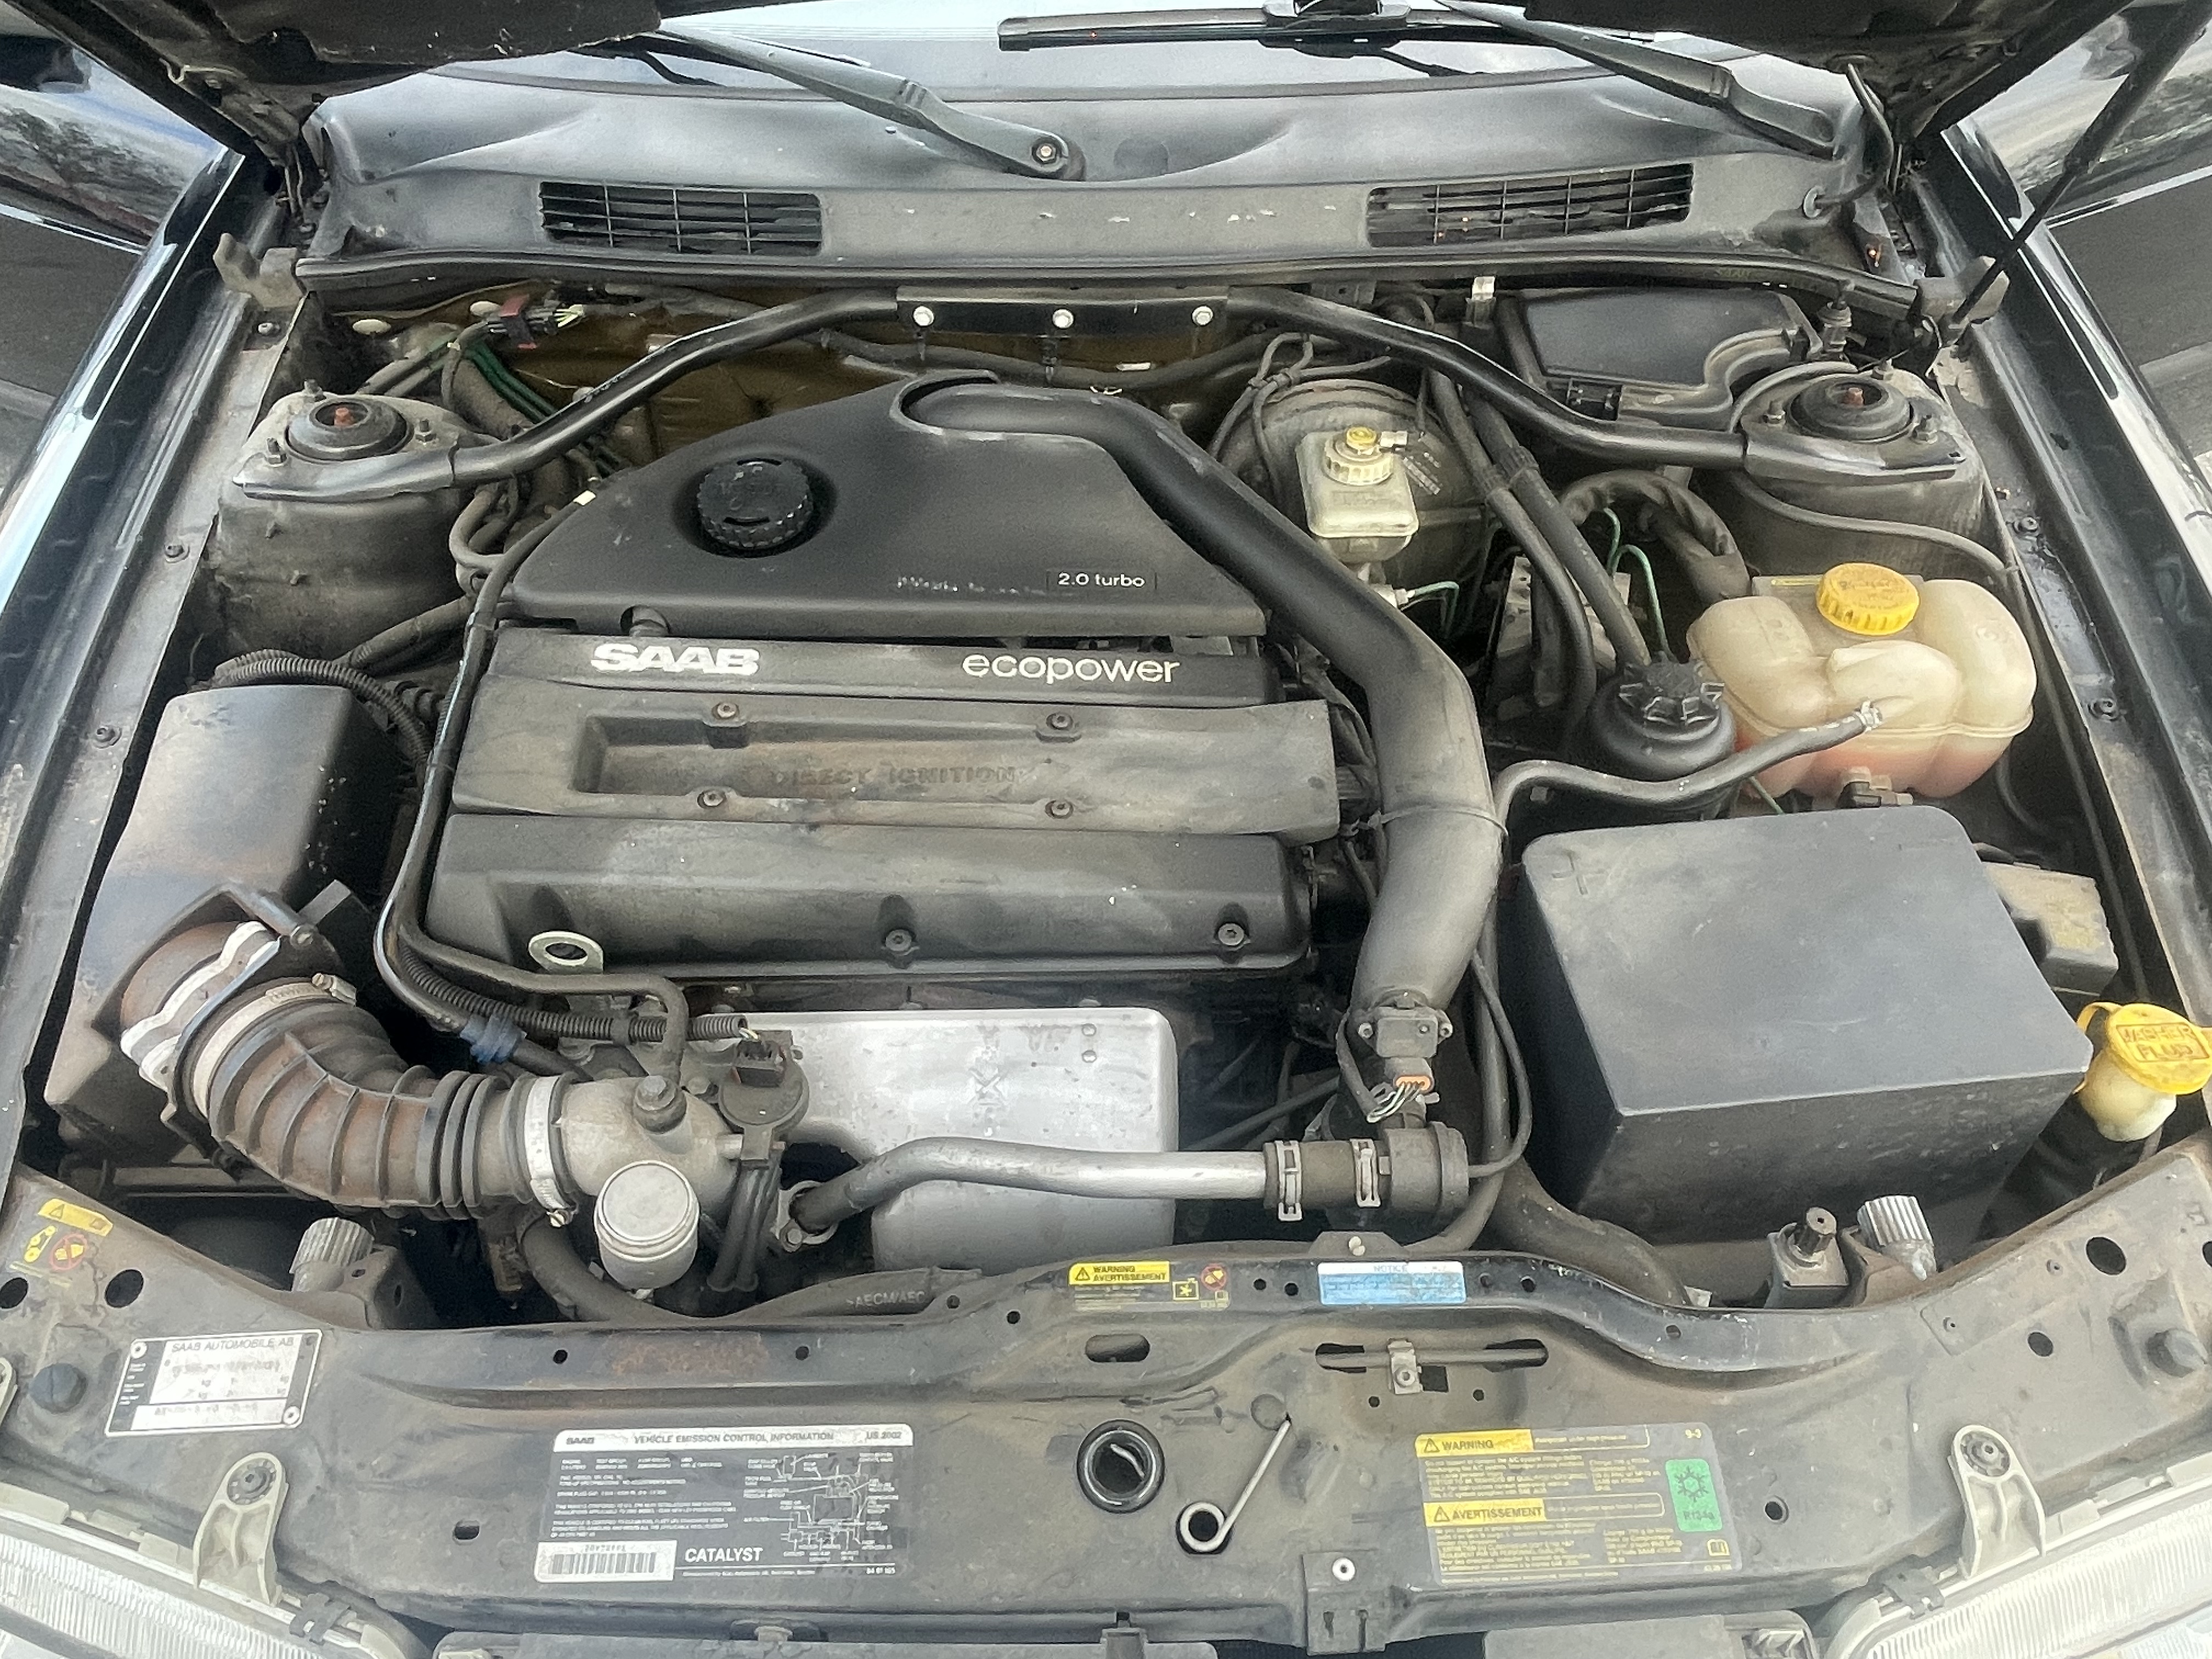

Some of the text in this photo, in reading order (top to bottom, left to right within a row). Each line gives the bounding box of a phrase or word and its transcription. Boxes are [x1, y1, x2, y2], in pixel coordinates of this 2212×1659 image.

[1058, 572, 1090, 586] 2.0
[1094, 573, 1146, 588] turbo
[590, 643, 760, 676] SAAB
[962, 654, 1180, 685] ecopower
[889, 767, 1015, 784] IGNITION
[2124, 1026, 2196, 1042] WASHER
[1373, 1265, 1408, 1273] NOTICE
[1093, 1273, 1166, 1282] AVERTISSEMENT
[172, 1336, 294, 1352] SAAB AUTOMOBILE AB
[634, 1434, 674, 1444] VEHICLE
[676, 1434, 720, 1443] EMISSION
[723, 1433, 766, 1442] CONTROL
[770, 1432, 834, 1441] INFORMATION
[1442, 1440, 1494, 1451] WARNING
[1452, 1506, 1543, 1520] AVERTISSEMENT
[685, 1547, 764, 1562] CATALYST
